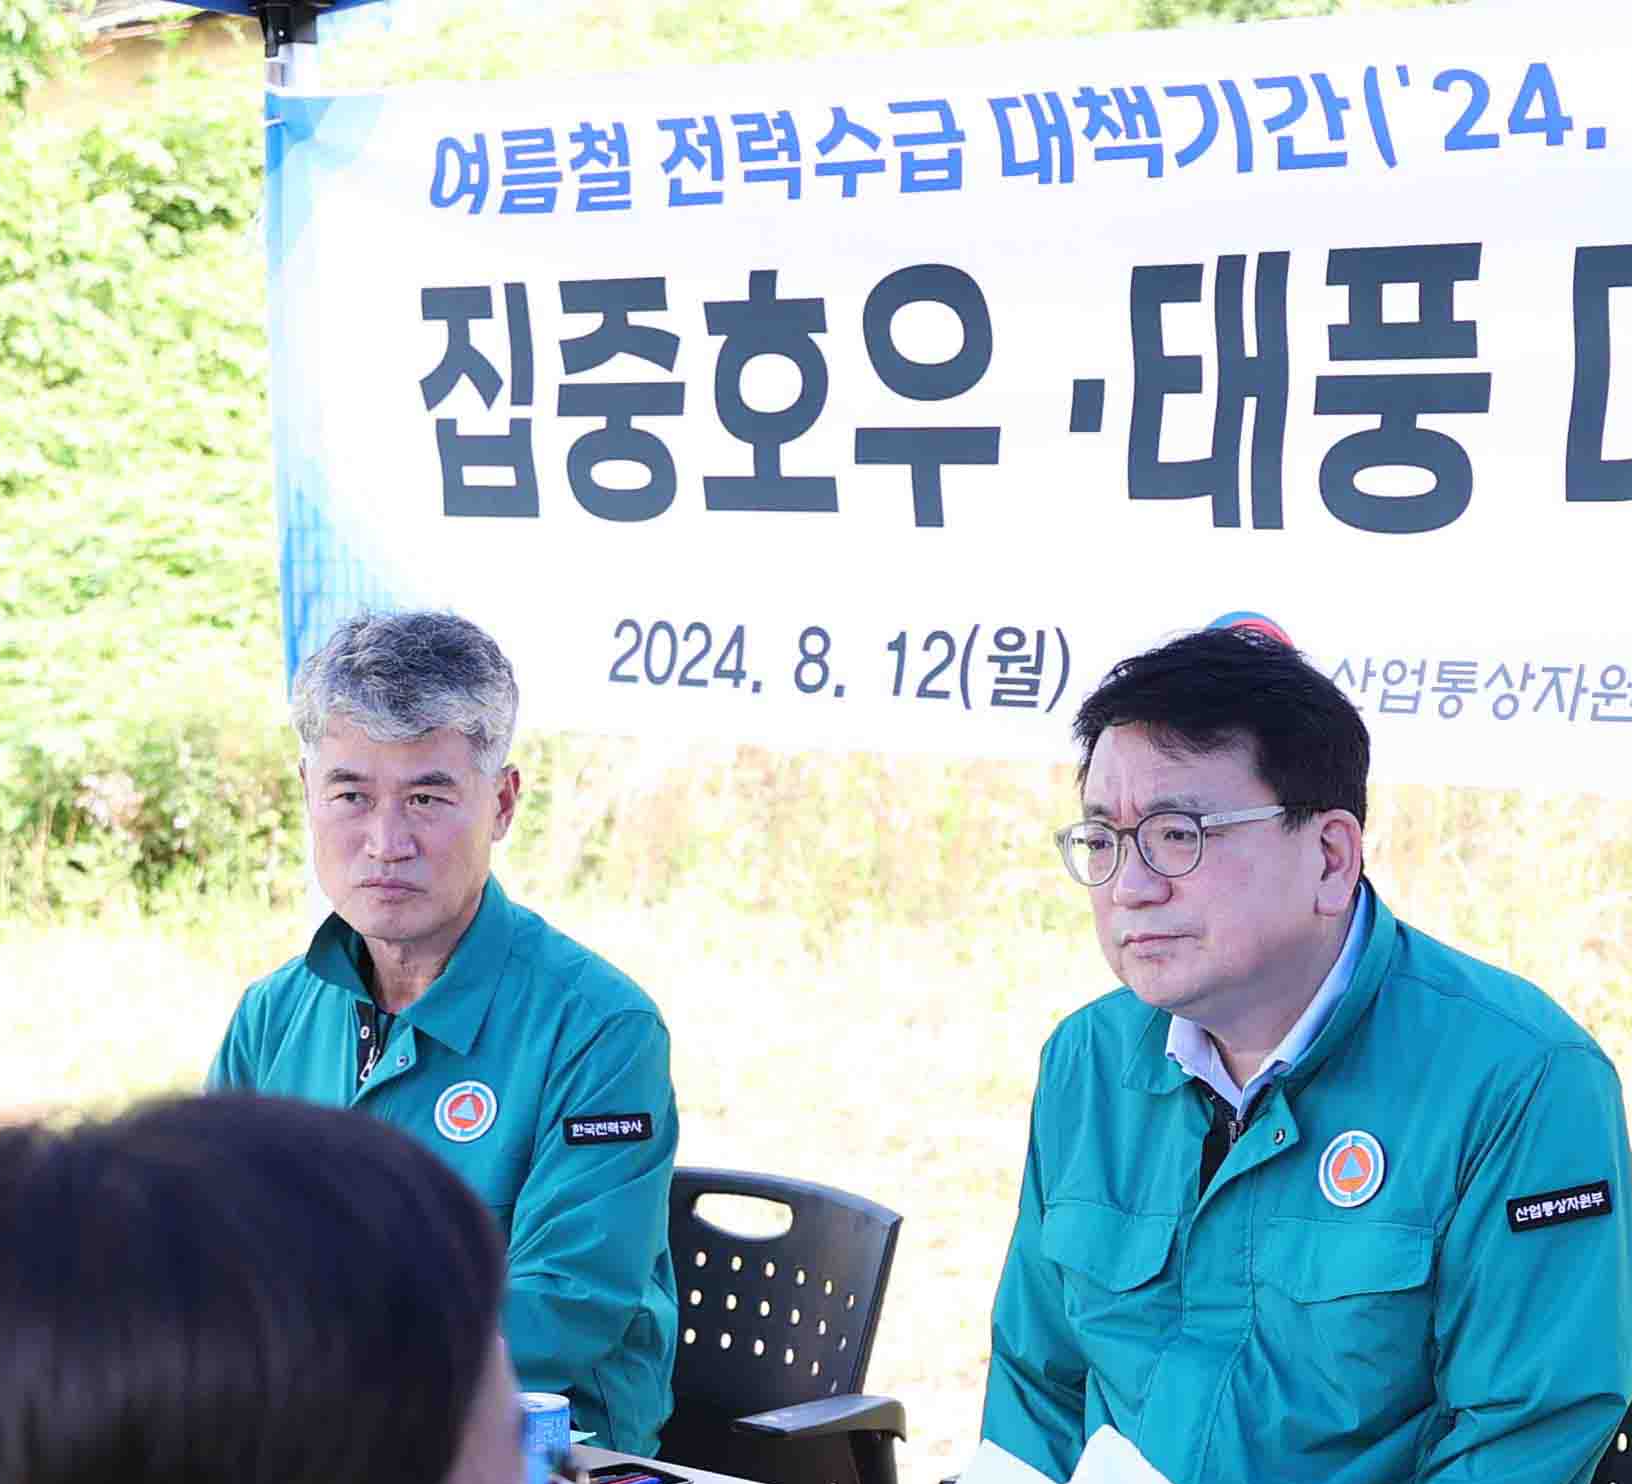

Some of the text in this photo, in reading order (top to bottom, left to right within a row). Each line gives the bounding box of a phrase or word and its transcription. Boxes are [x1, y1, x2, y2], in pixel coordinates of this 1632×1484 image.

[430, 122, 634, 217] 여름철
[657, 99, 968, 209] 전력수급
[420, 264, 1002, 529] 집중호우
[610, 619, 1071, 712] 2024. 8. 12(월)
[571, 1119, 643, 1138] 한국전력공사
[1515, 1191, 1605, 1223] 산업통상자원부
